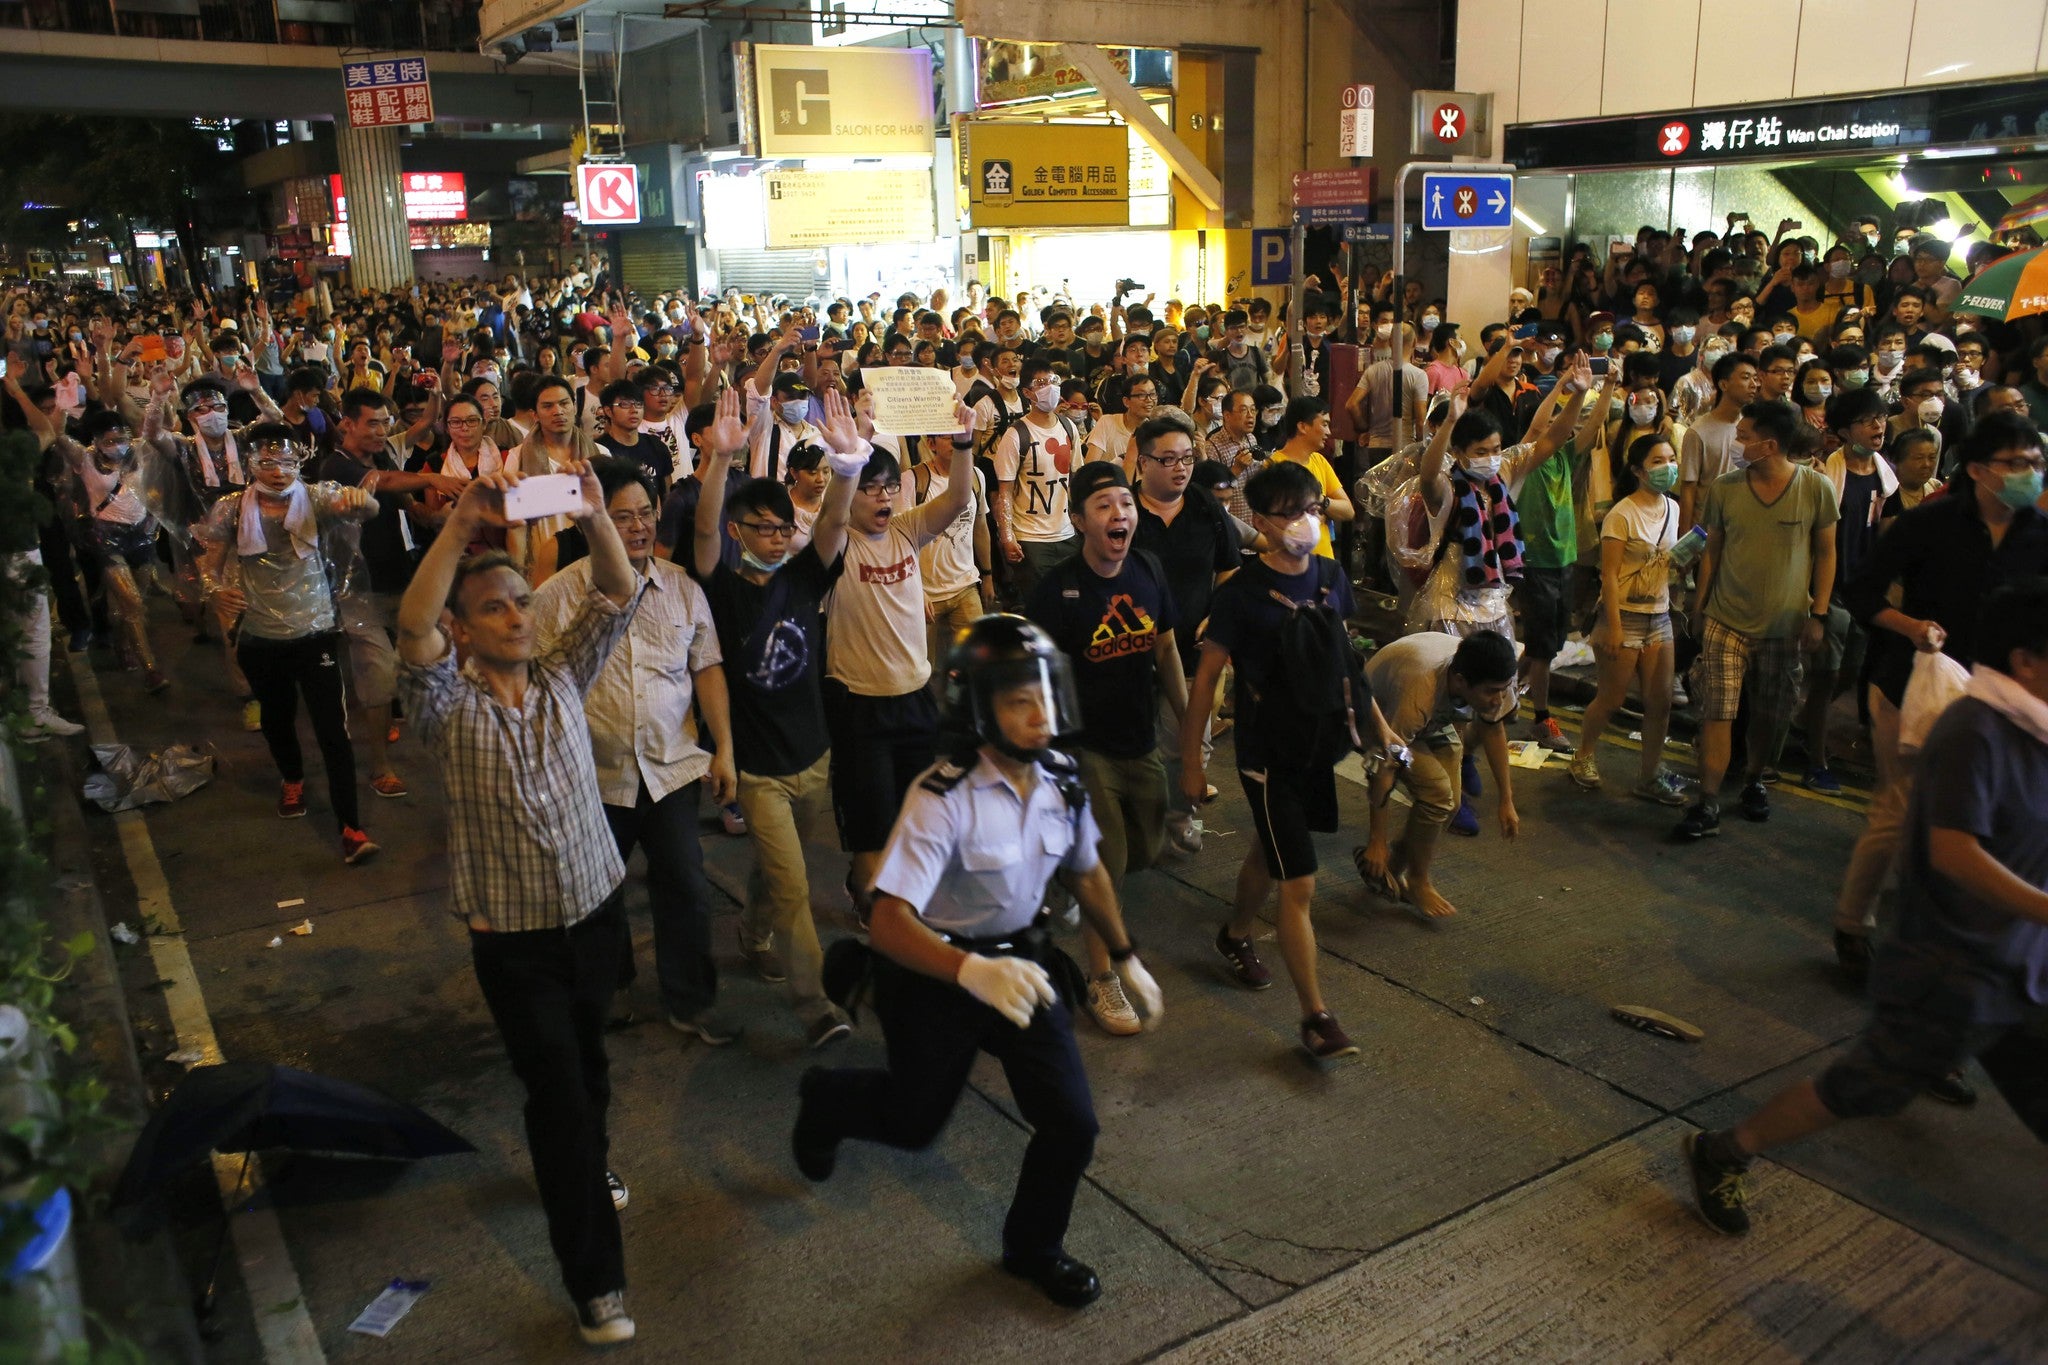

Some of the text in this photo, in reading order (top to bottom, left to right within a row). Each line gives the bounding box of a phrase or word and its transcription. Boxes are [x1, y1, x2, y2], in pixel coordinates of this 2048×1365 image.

[347, 60, 424, 87] 美堅時
[770, 68, 832, 136] G
[835, 124, 924, 136] SALON FOR HAIR
[1342, 114, 1355, 152] 灣仔
[1700, 116, 1783, 151] 灣仔站
[1786, 121, 1900, 145] Wan Chai Station
[985, 163, 1010, 194] 金
[1033, 165, 1117, 184] 金電腦用品
[1261, 235, 1285, 280] P
[2020, 295, 2048, 309] 7-EL
[1026, 441, 1045, 477] I
[1087, 631, 1155, 658] adidas
